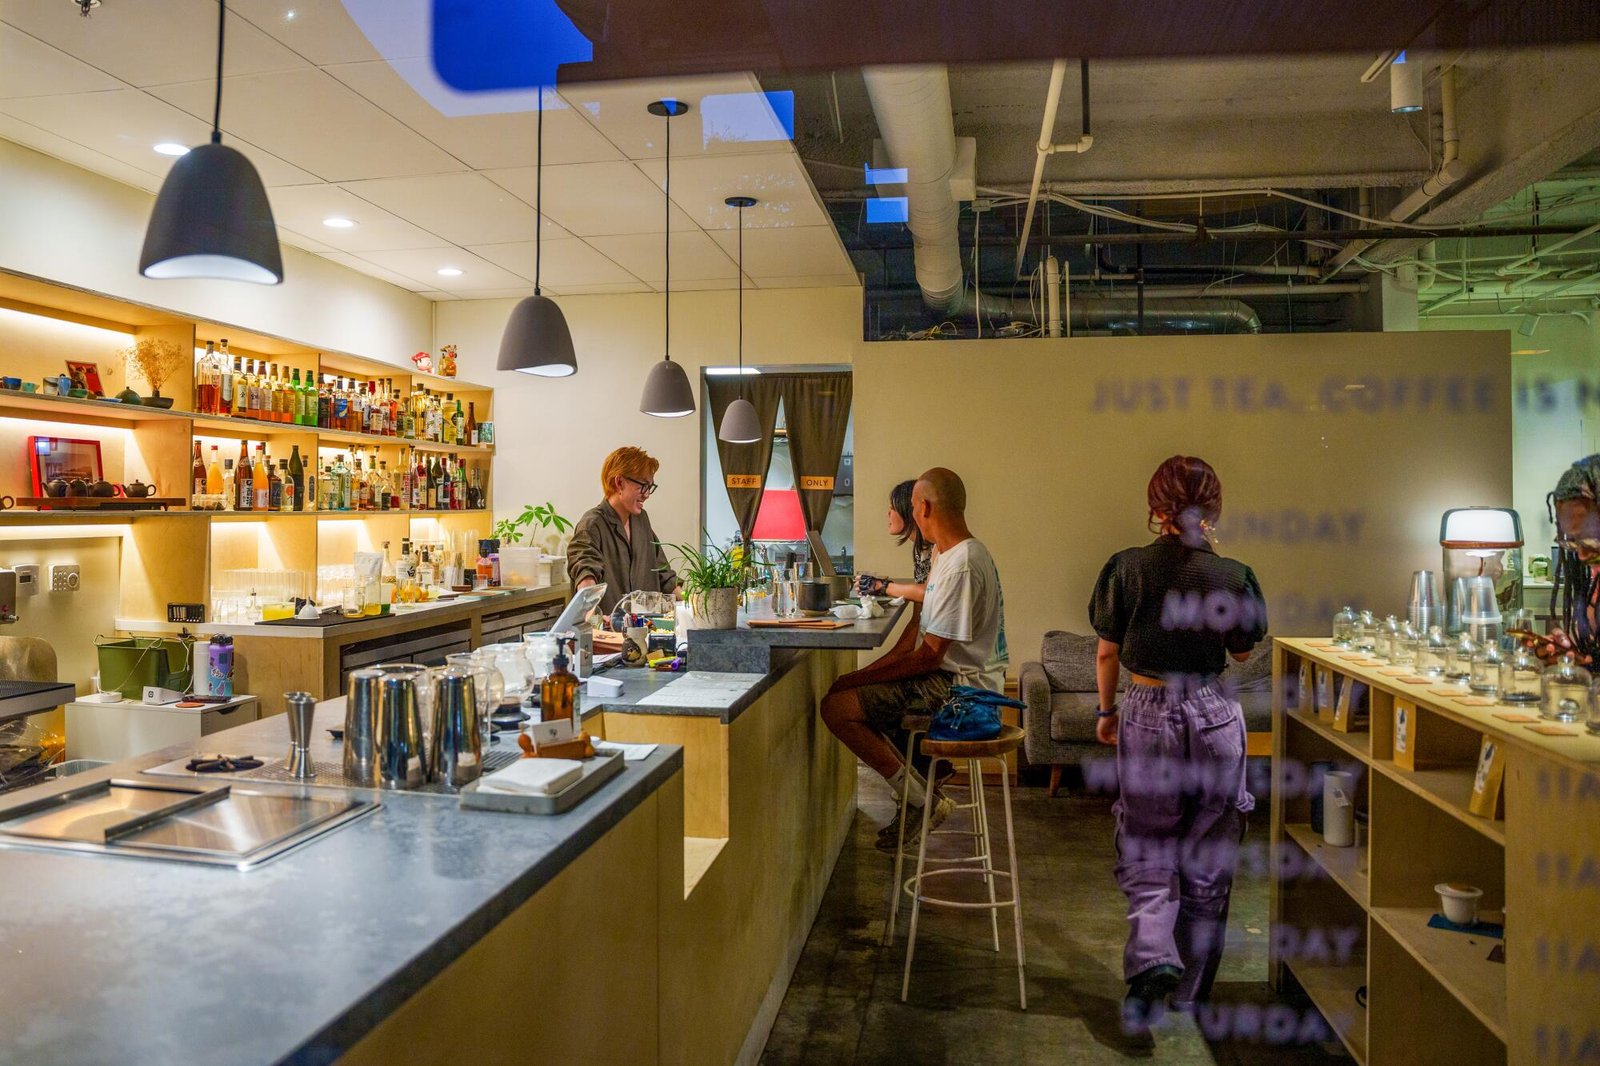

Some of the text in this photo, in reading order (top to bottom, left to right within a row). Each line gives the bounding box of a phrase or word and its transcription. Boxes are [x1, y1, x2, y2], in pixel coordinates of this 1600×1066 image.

[1092, 376, 1193, 414] JUST
[1317, 374, 1498, 415] COFFEE
[731, 477, 757, 486] STAFF
[806, 479, 829, 487] ONLY
